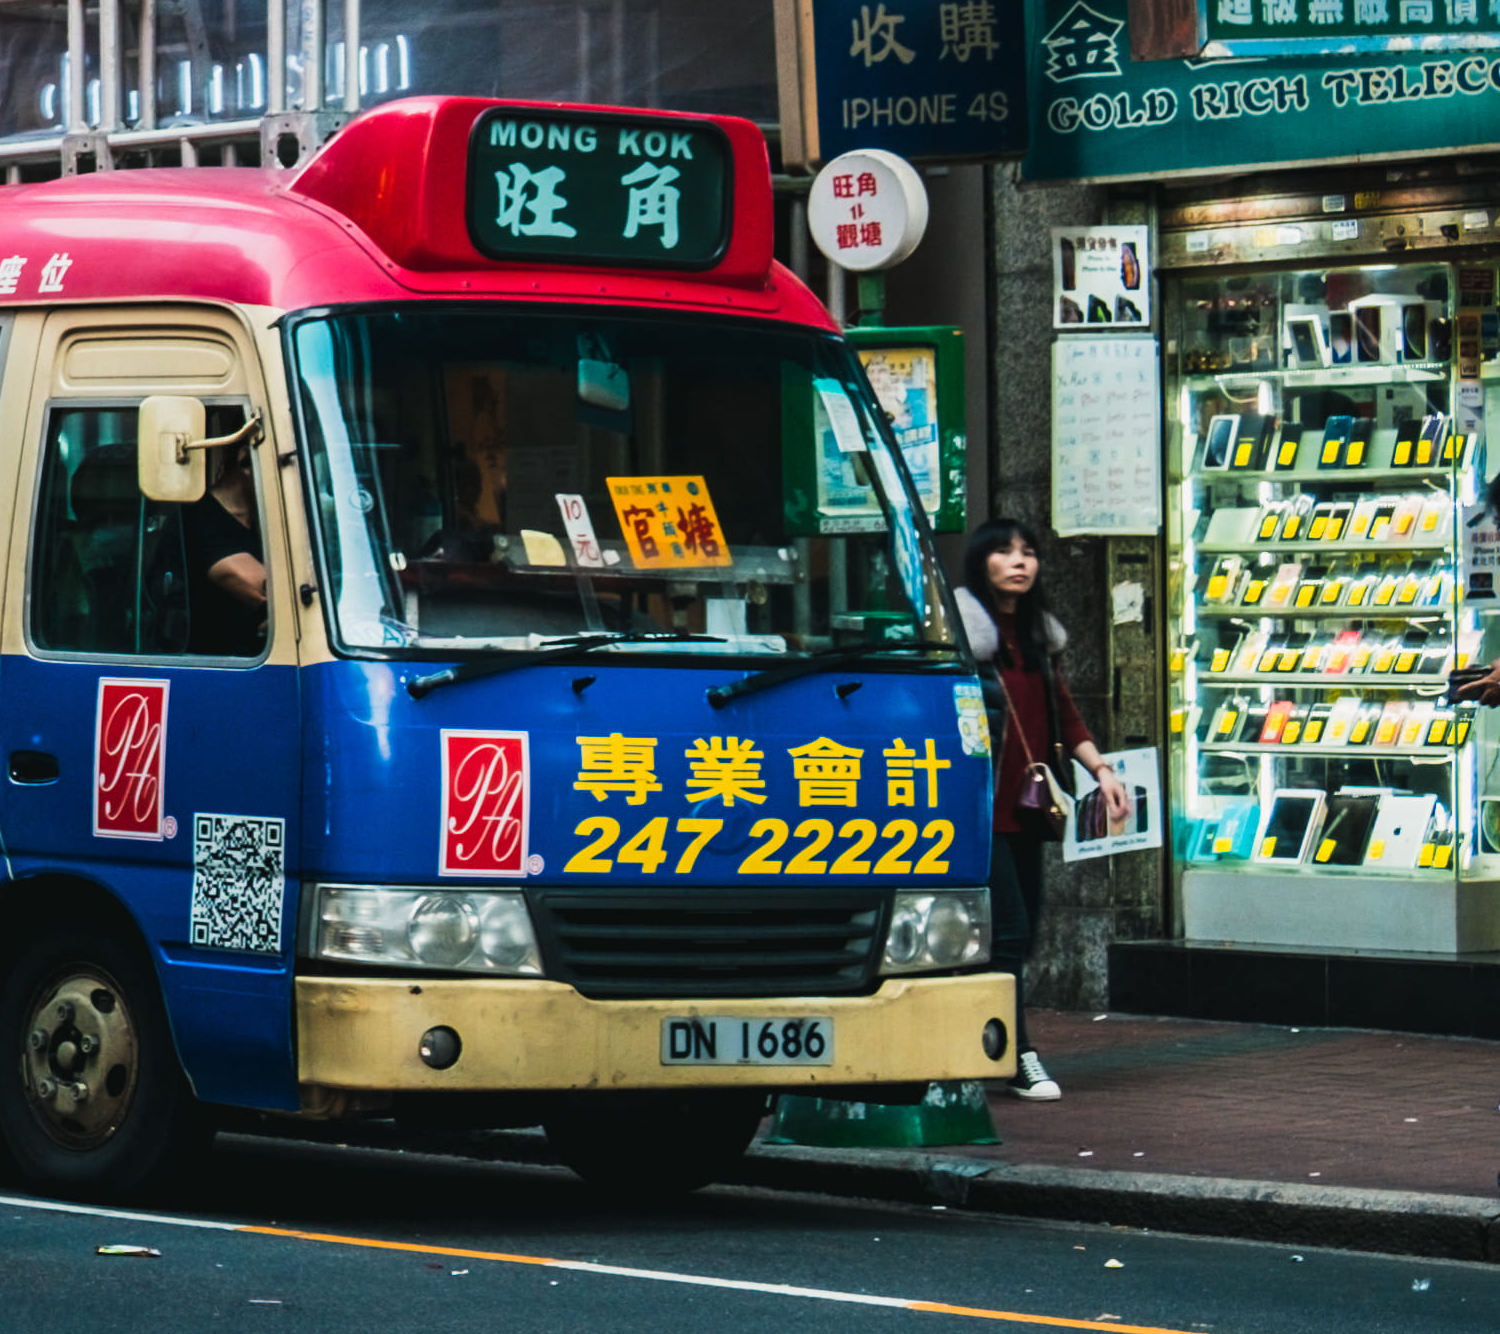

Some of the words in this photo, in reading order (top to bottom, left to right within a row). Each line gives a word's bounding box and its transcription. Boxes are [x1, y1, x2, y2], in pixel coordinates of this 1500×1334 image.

[841, 96, 958, 130] IPHONE
[966, 91, 1009, 124] 4S
[1047, 87, 1178, 134] GOLD
[1191, 73, 1310, 121] RICH
[491, 120, 600, 155] MONG
[617, 130, 694, 161] KOK
[496, 160, 682, 250] 旺角
[832, 171, 878, 200] 旺角
[836, 222, 883, 249] 觀塘
[574, 733, 952, 808] 專業會計
[564, 815, 719, 875] 247
[735, 817, 956, 875] 22222
[670, 1023, 725, 1059] DN
[741, 1018, 825, 1060] 1686
